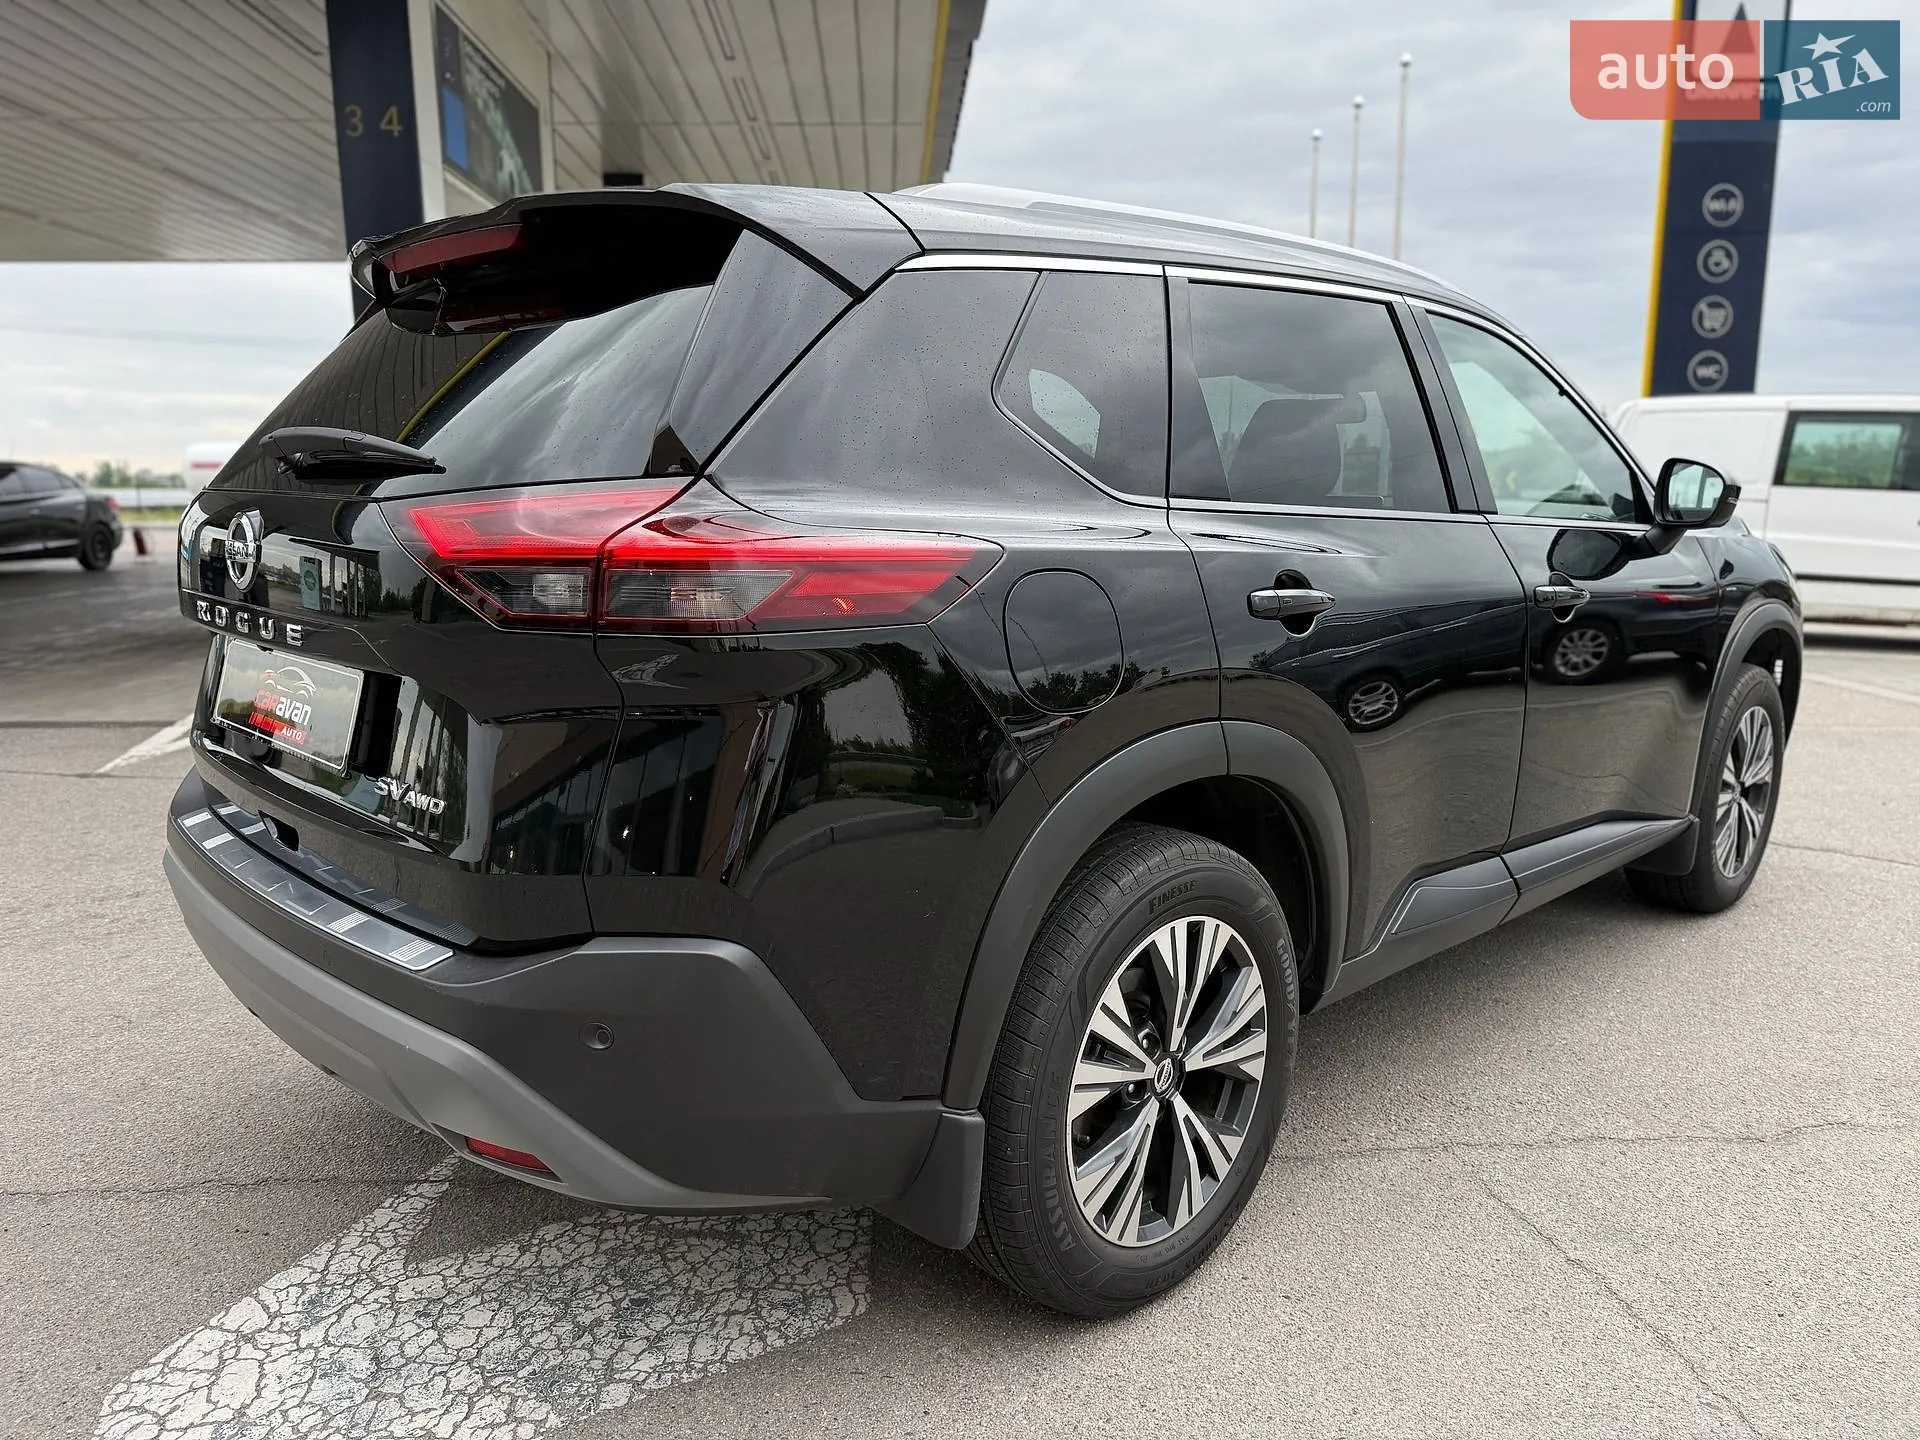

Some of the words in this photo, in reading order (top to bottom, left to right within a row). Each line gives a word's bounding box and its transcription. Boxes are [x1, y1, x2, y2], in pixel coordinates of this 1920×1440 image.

[343, 105, 364, 137] 3
[379, 105, 404, 137] 4
[196, 600, 306, 647] ROGUE
[280, 726, 303, 741] AUTO
[374, 776, 411, 801] SV
[402, 789, 447, 815] AWD
[1148, 878, 1198, 917] FINESSE
[1040, 1070, 1077, 1252] ASSURANCE
